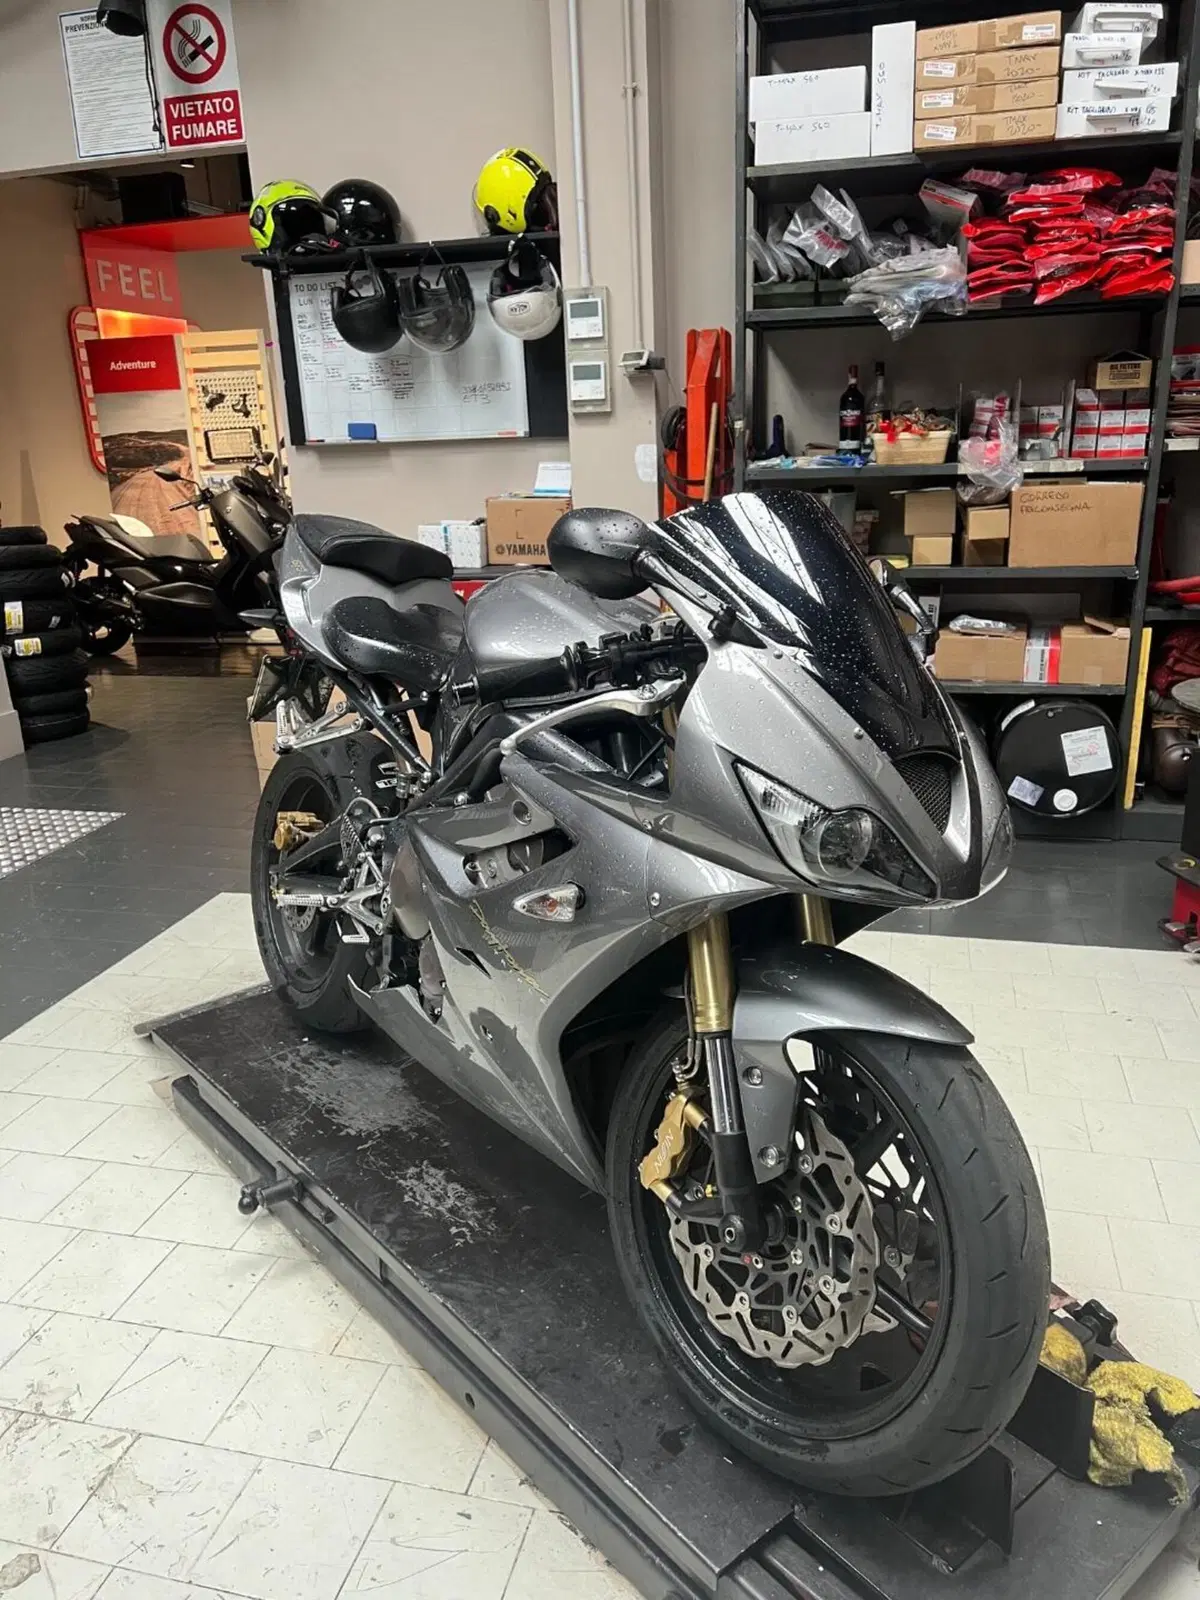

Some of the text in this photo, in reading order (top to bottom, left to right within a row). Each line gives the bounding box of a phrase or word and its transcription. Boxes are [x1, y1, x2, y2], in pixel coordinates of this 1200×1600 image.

[169, 97, 235, 119] VIETATO
[172, 118, 237, 141] FUMARE
[96, 260, 174, 302] FEEL
[109, 360, 157, 371] Adventure
[504, 543, 547, 557] YAMAHA
